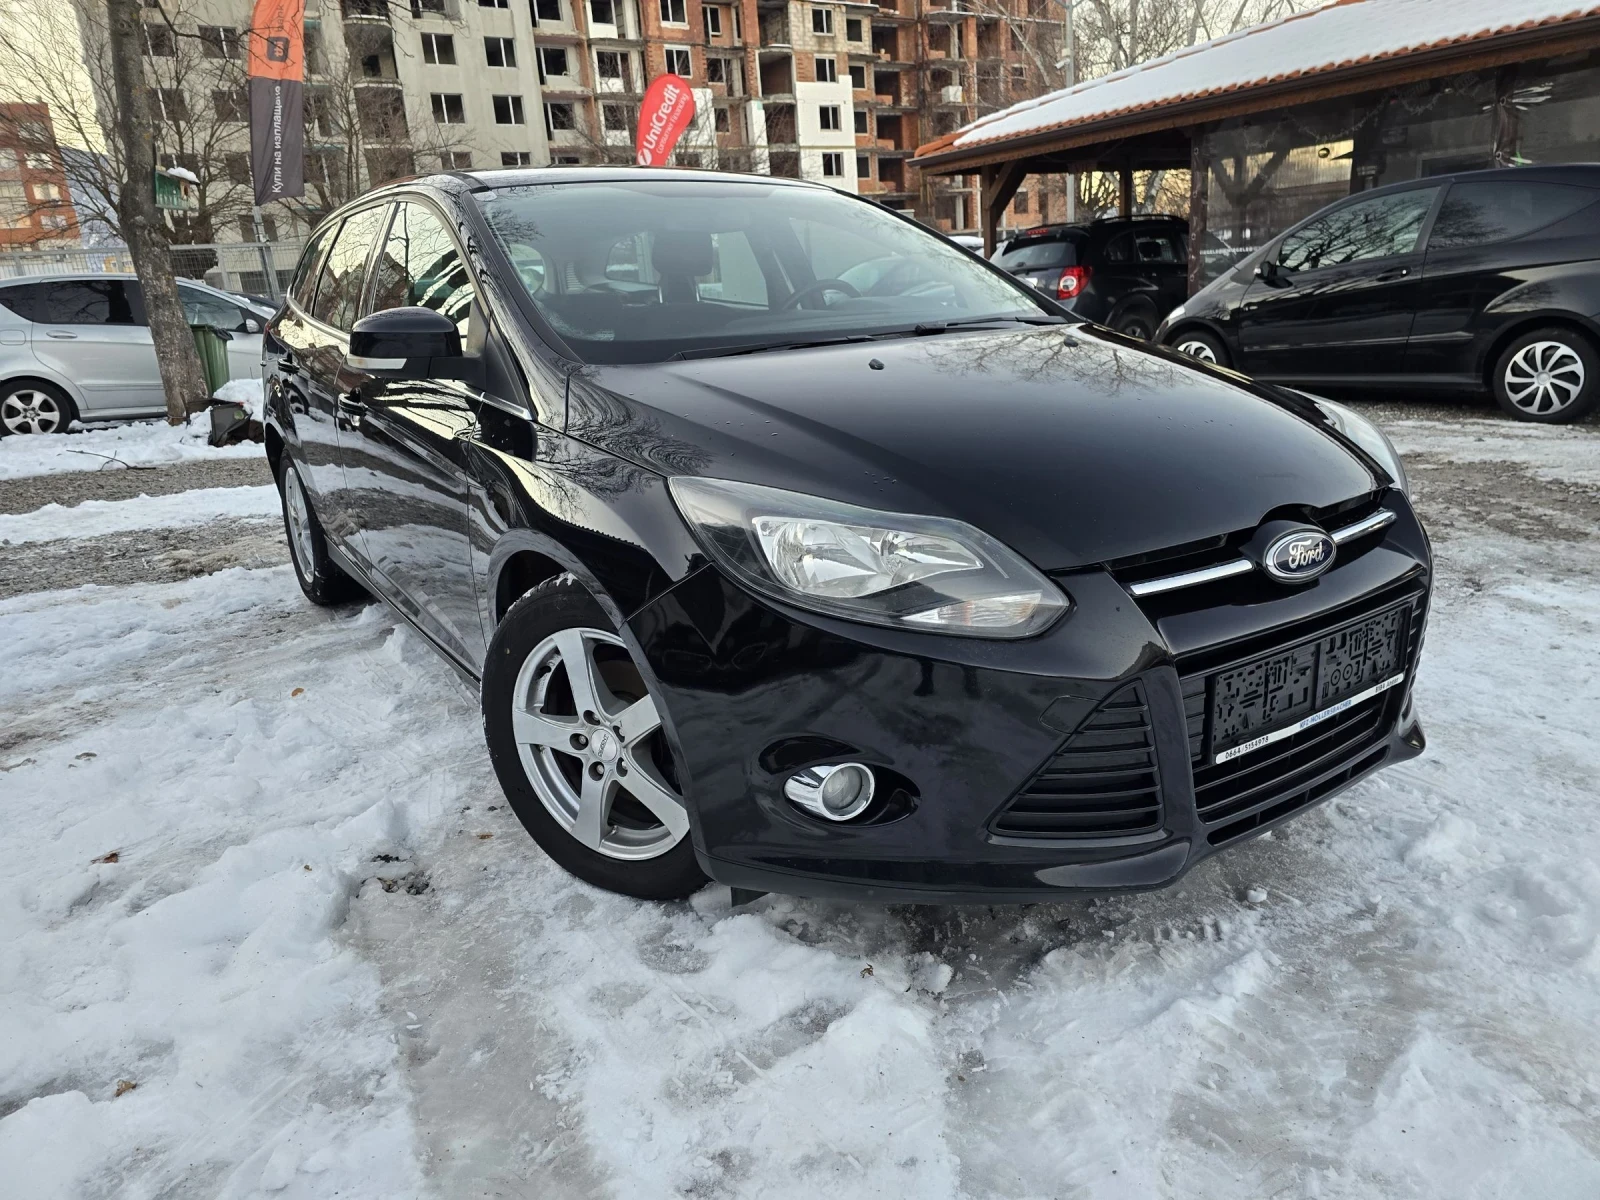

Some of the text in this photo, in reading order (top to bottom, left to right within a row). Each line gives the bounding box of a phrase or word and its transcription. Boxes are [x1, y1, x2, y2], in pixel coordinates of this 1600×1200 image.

[643, 84, 680, 149] UniCredit
[655, 93, 690, 154] Consumer Financing
[274, 151, 282, 164] на
[272, 166, 284, 193] Купи
[1288, 538, 1325, 569] Ford
